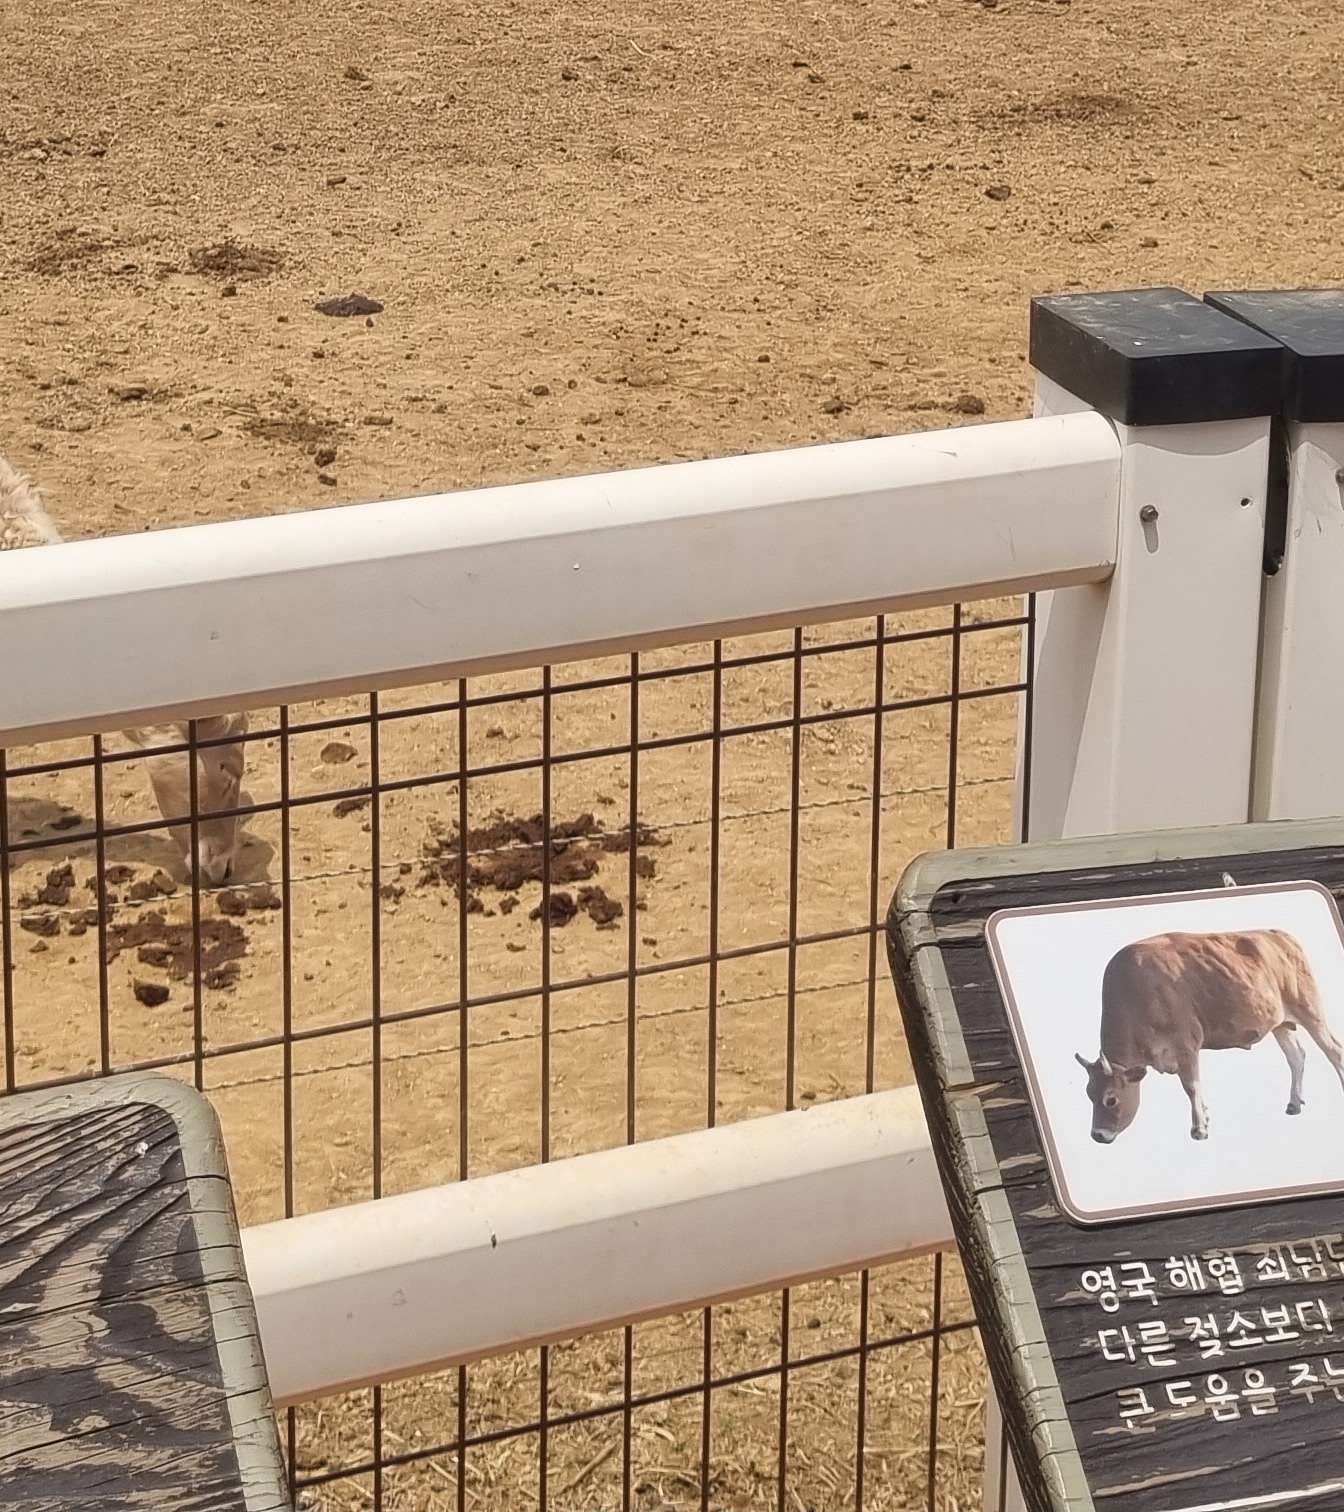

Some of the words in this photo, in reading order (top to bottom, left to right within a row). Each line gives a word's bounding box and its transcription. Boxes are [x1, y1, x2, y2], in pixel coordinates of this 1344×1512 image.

[1081, 1261, 1159, 1314] 영국
[1164, 1253, 1245, 1295] 해협
[1097, 1319, 1177, 1367] 다른
[1183, 1297, 1336, 1360] 젖소보다
[1165, 1367, 1280, 1422] 도움을
